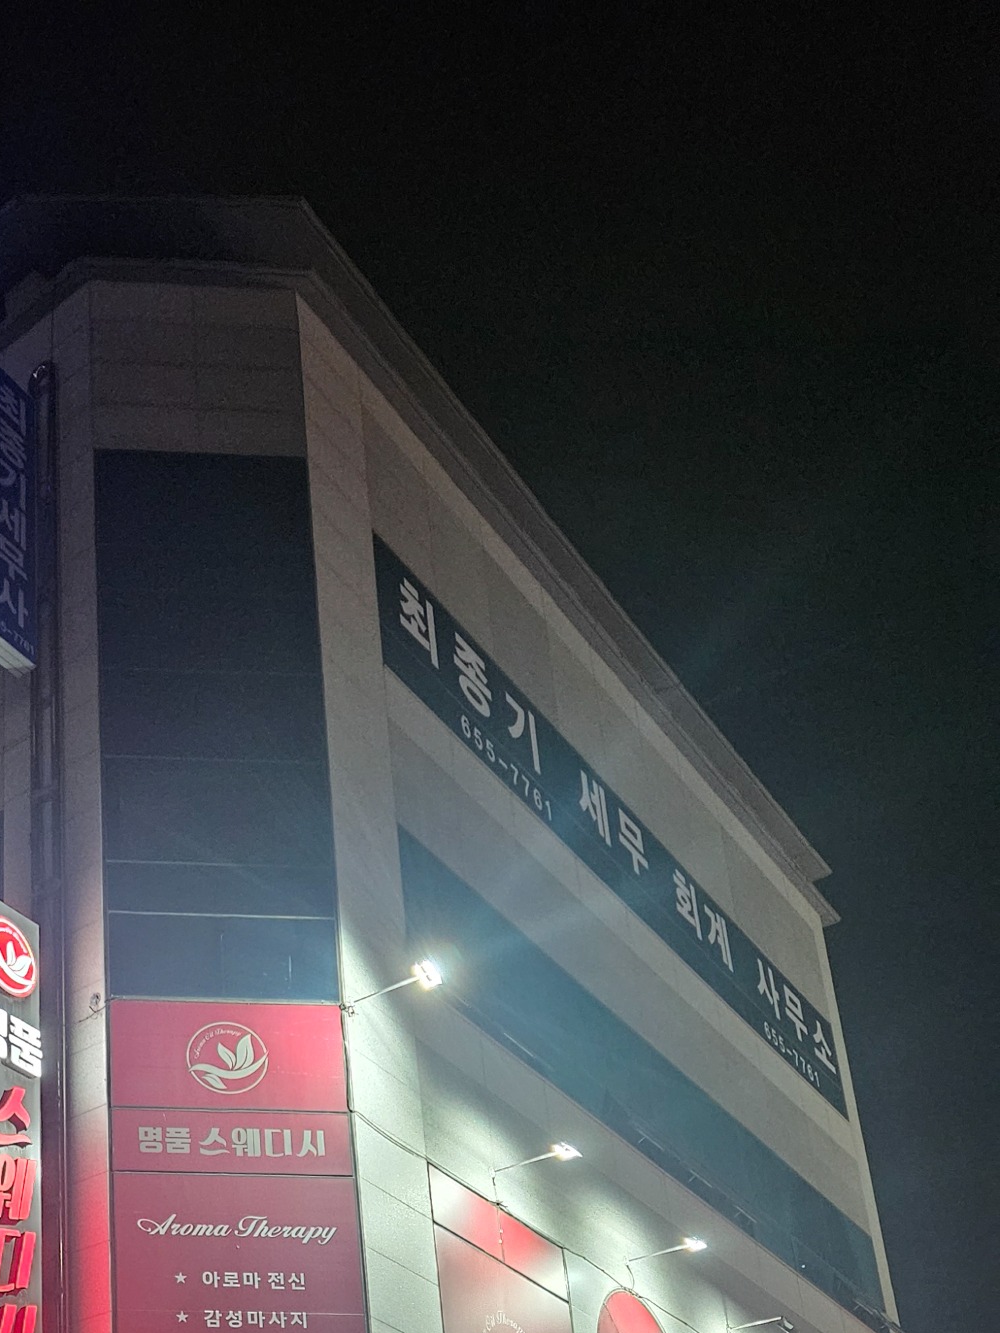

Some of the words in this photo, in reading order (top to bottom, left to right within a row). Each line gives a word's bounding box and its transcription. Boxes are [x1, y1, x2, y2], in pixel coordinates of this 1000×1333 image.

[460, 714, 553, 820] 655-7761
[399, 577, 541, 775] 최종기
[580, 770, 649, 874] 세무
[672, 869, 734, 972] 회계
[757, 957, 836, 1073] 사무소
[763, 1020, 819, 1087] 655-7761
[138, 1126, 191, 1155] 명품
[199, 1127, 326, 1158] 스웨디시
[137, 1213, 232, 1238] Aroma
[234, 1215, 337, 1245] Therapy
[201, 1271, 261, 1290] 아로마
[267, 1272, 307, 1291] 전신
[203, 1309, 310, 1330] 감성마사지
